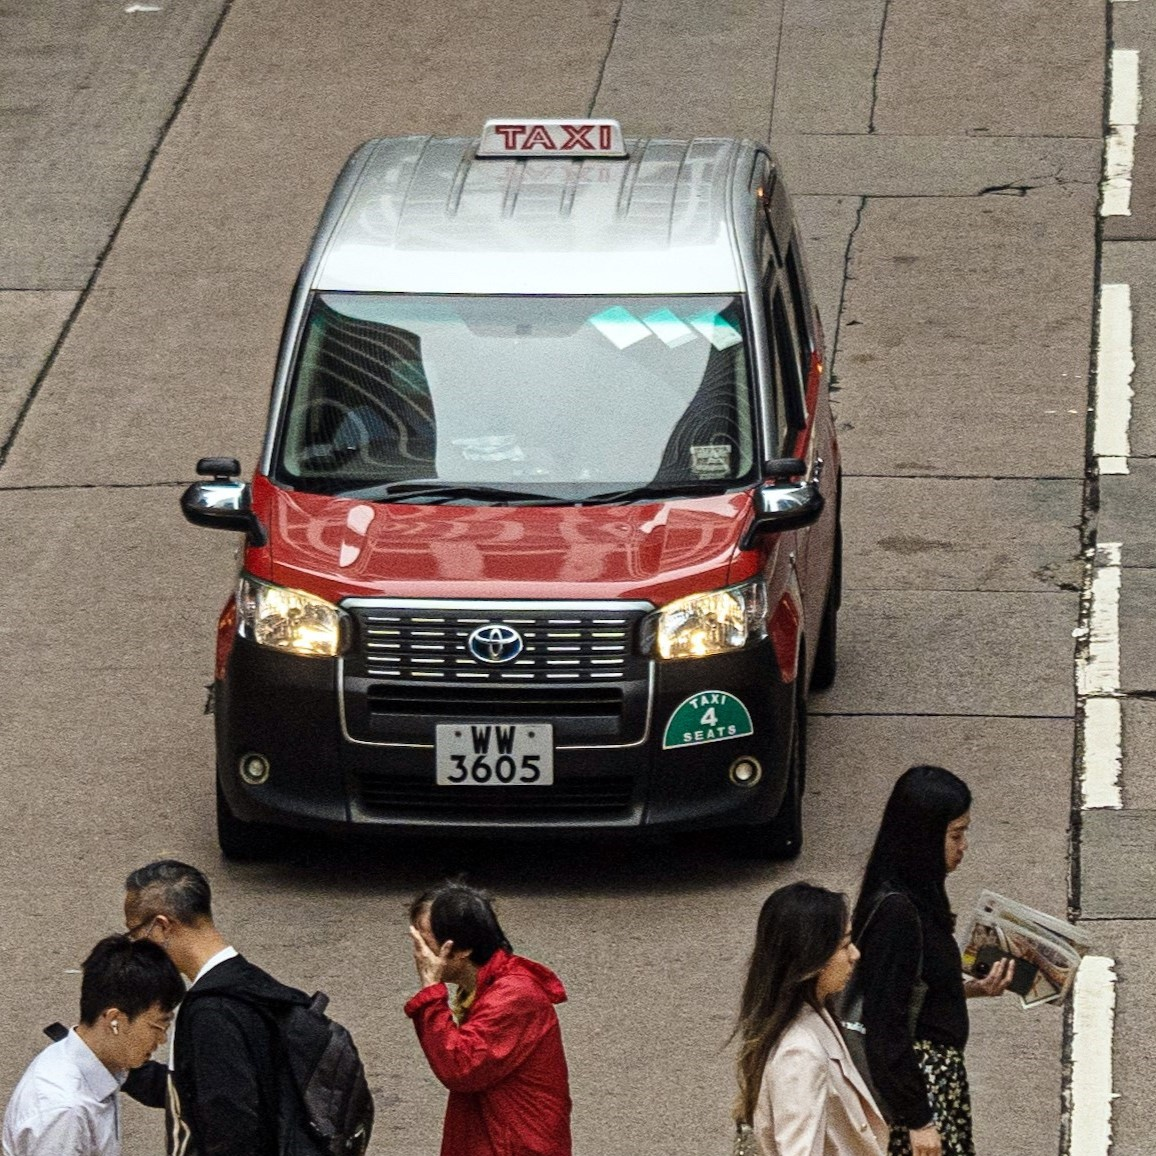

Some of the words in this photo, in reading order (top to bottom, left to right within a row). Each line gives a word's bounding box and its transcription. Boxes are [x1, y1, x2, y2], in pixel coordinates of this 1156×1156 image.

[495, 125, 612, 151] TAXI
[688, 693, 727, 709] TAXI
[700, 706, 719, 727] 4
[471, 725, 516, 755] WW
[682, 724, 737, 742] SEATS
[447, 754, 541, 784] 3605
